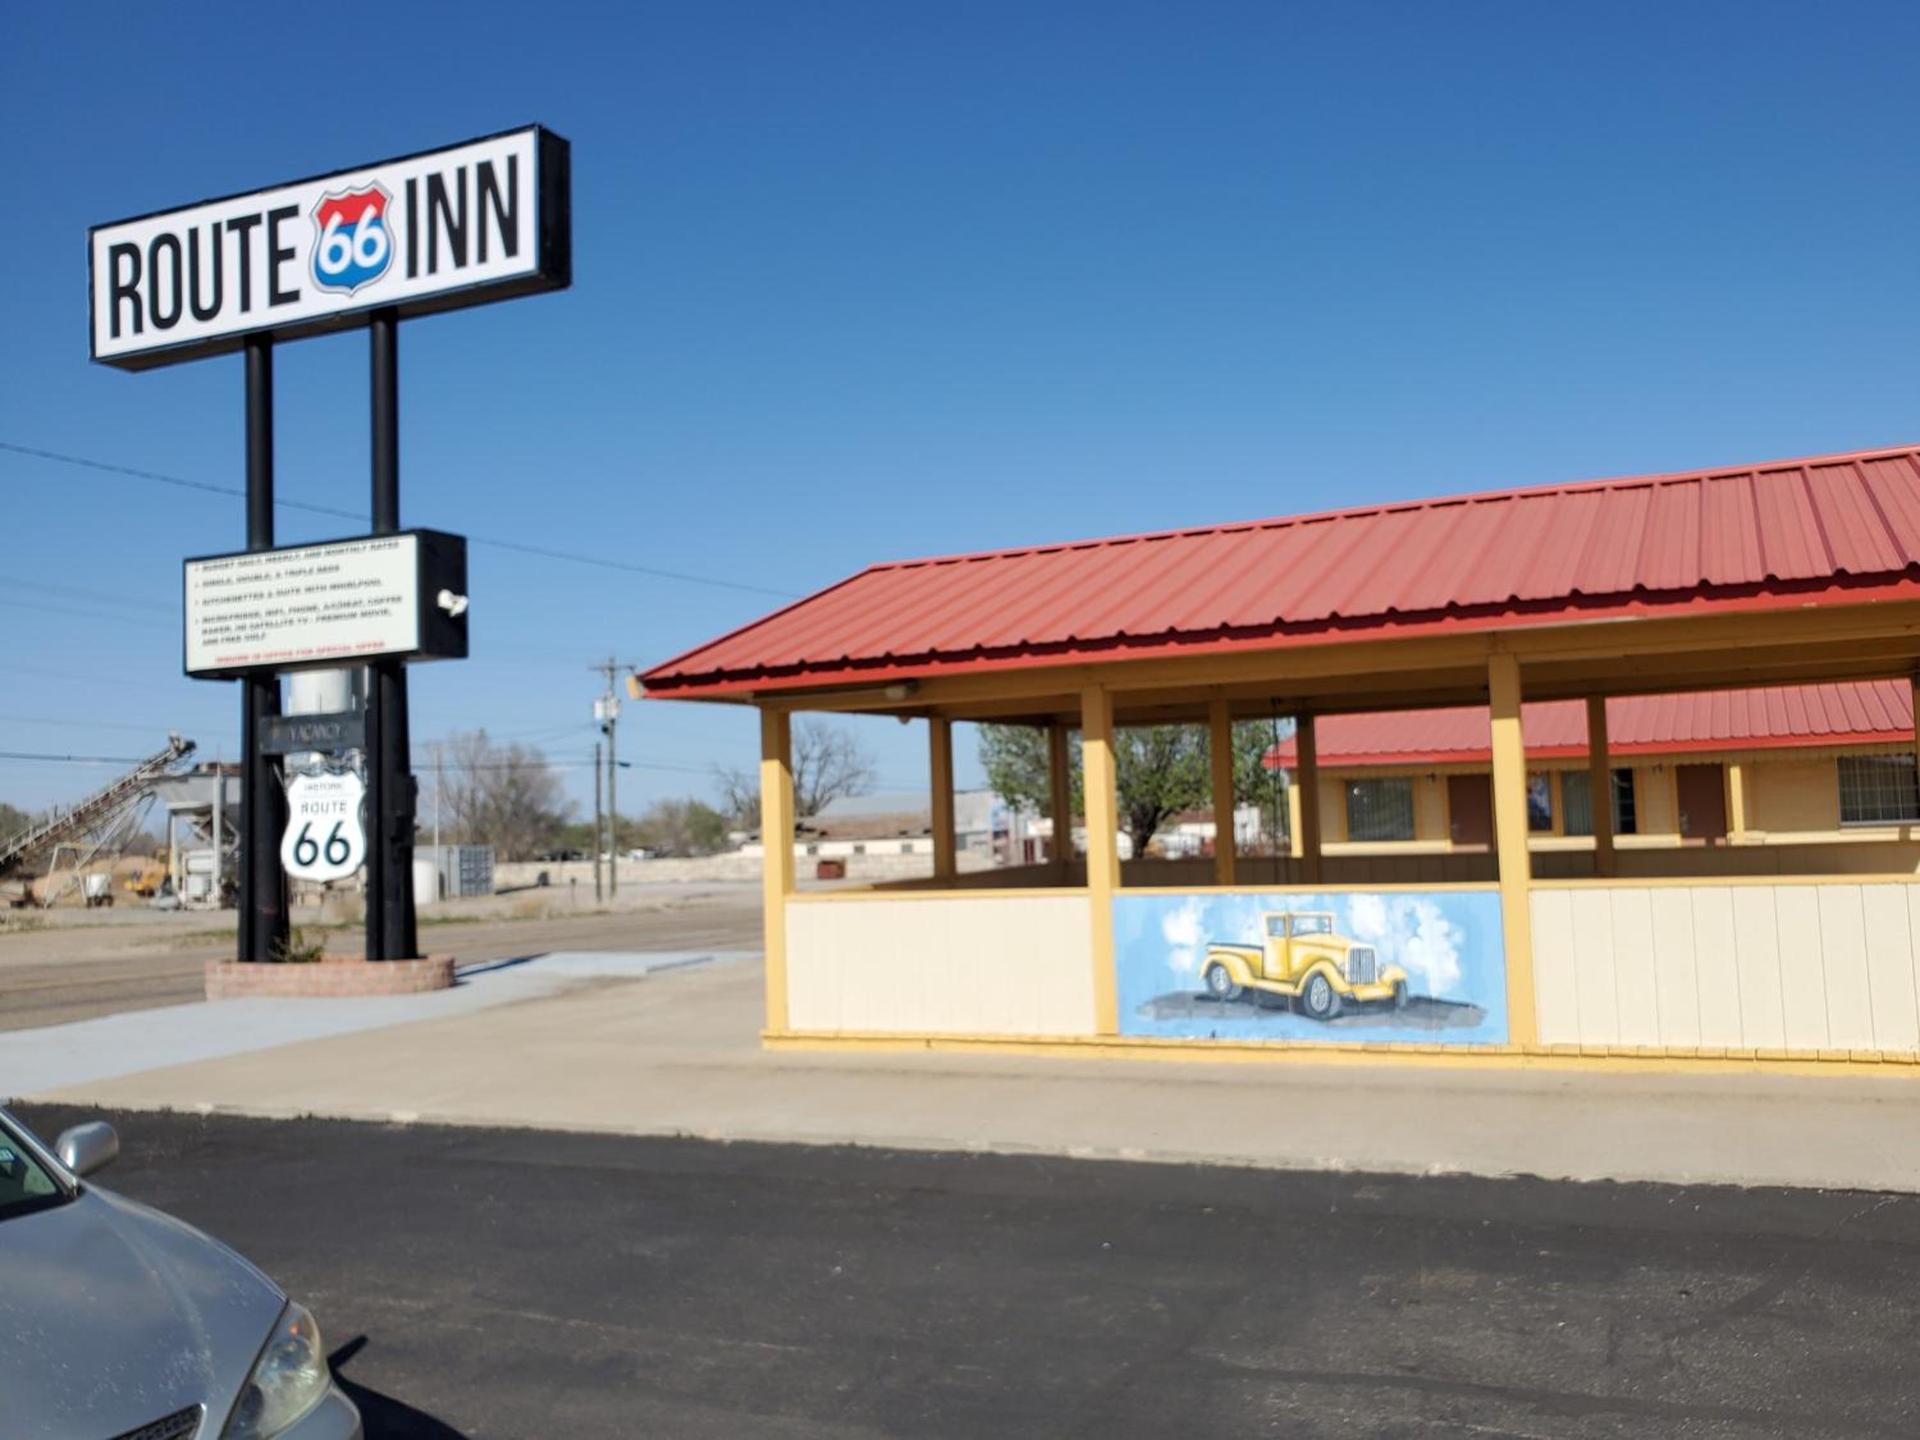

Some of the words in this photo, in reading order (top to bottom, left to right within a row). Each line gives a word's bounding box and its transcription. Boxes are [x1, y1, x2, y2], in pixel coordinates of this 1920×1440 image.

[109, 204, 301, 339] ROUTE
[318, 203, 388, 275] 66
[405, 153, 518, 280] INN
[290, 722, 341, 742] VACANCY
[300, 800, 348, 816] ROUTE
[294, 820, 350, 867] 66
